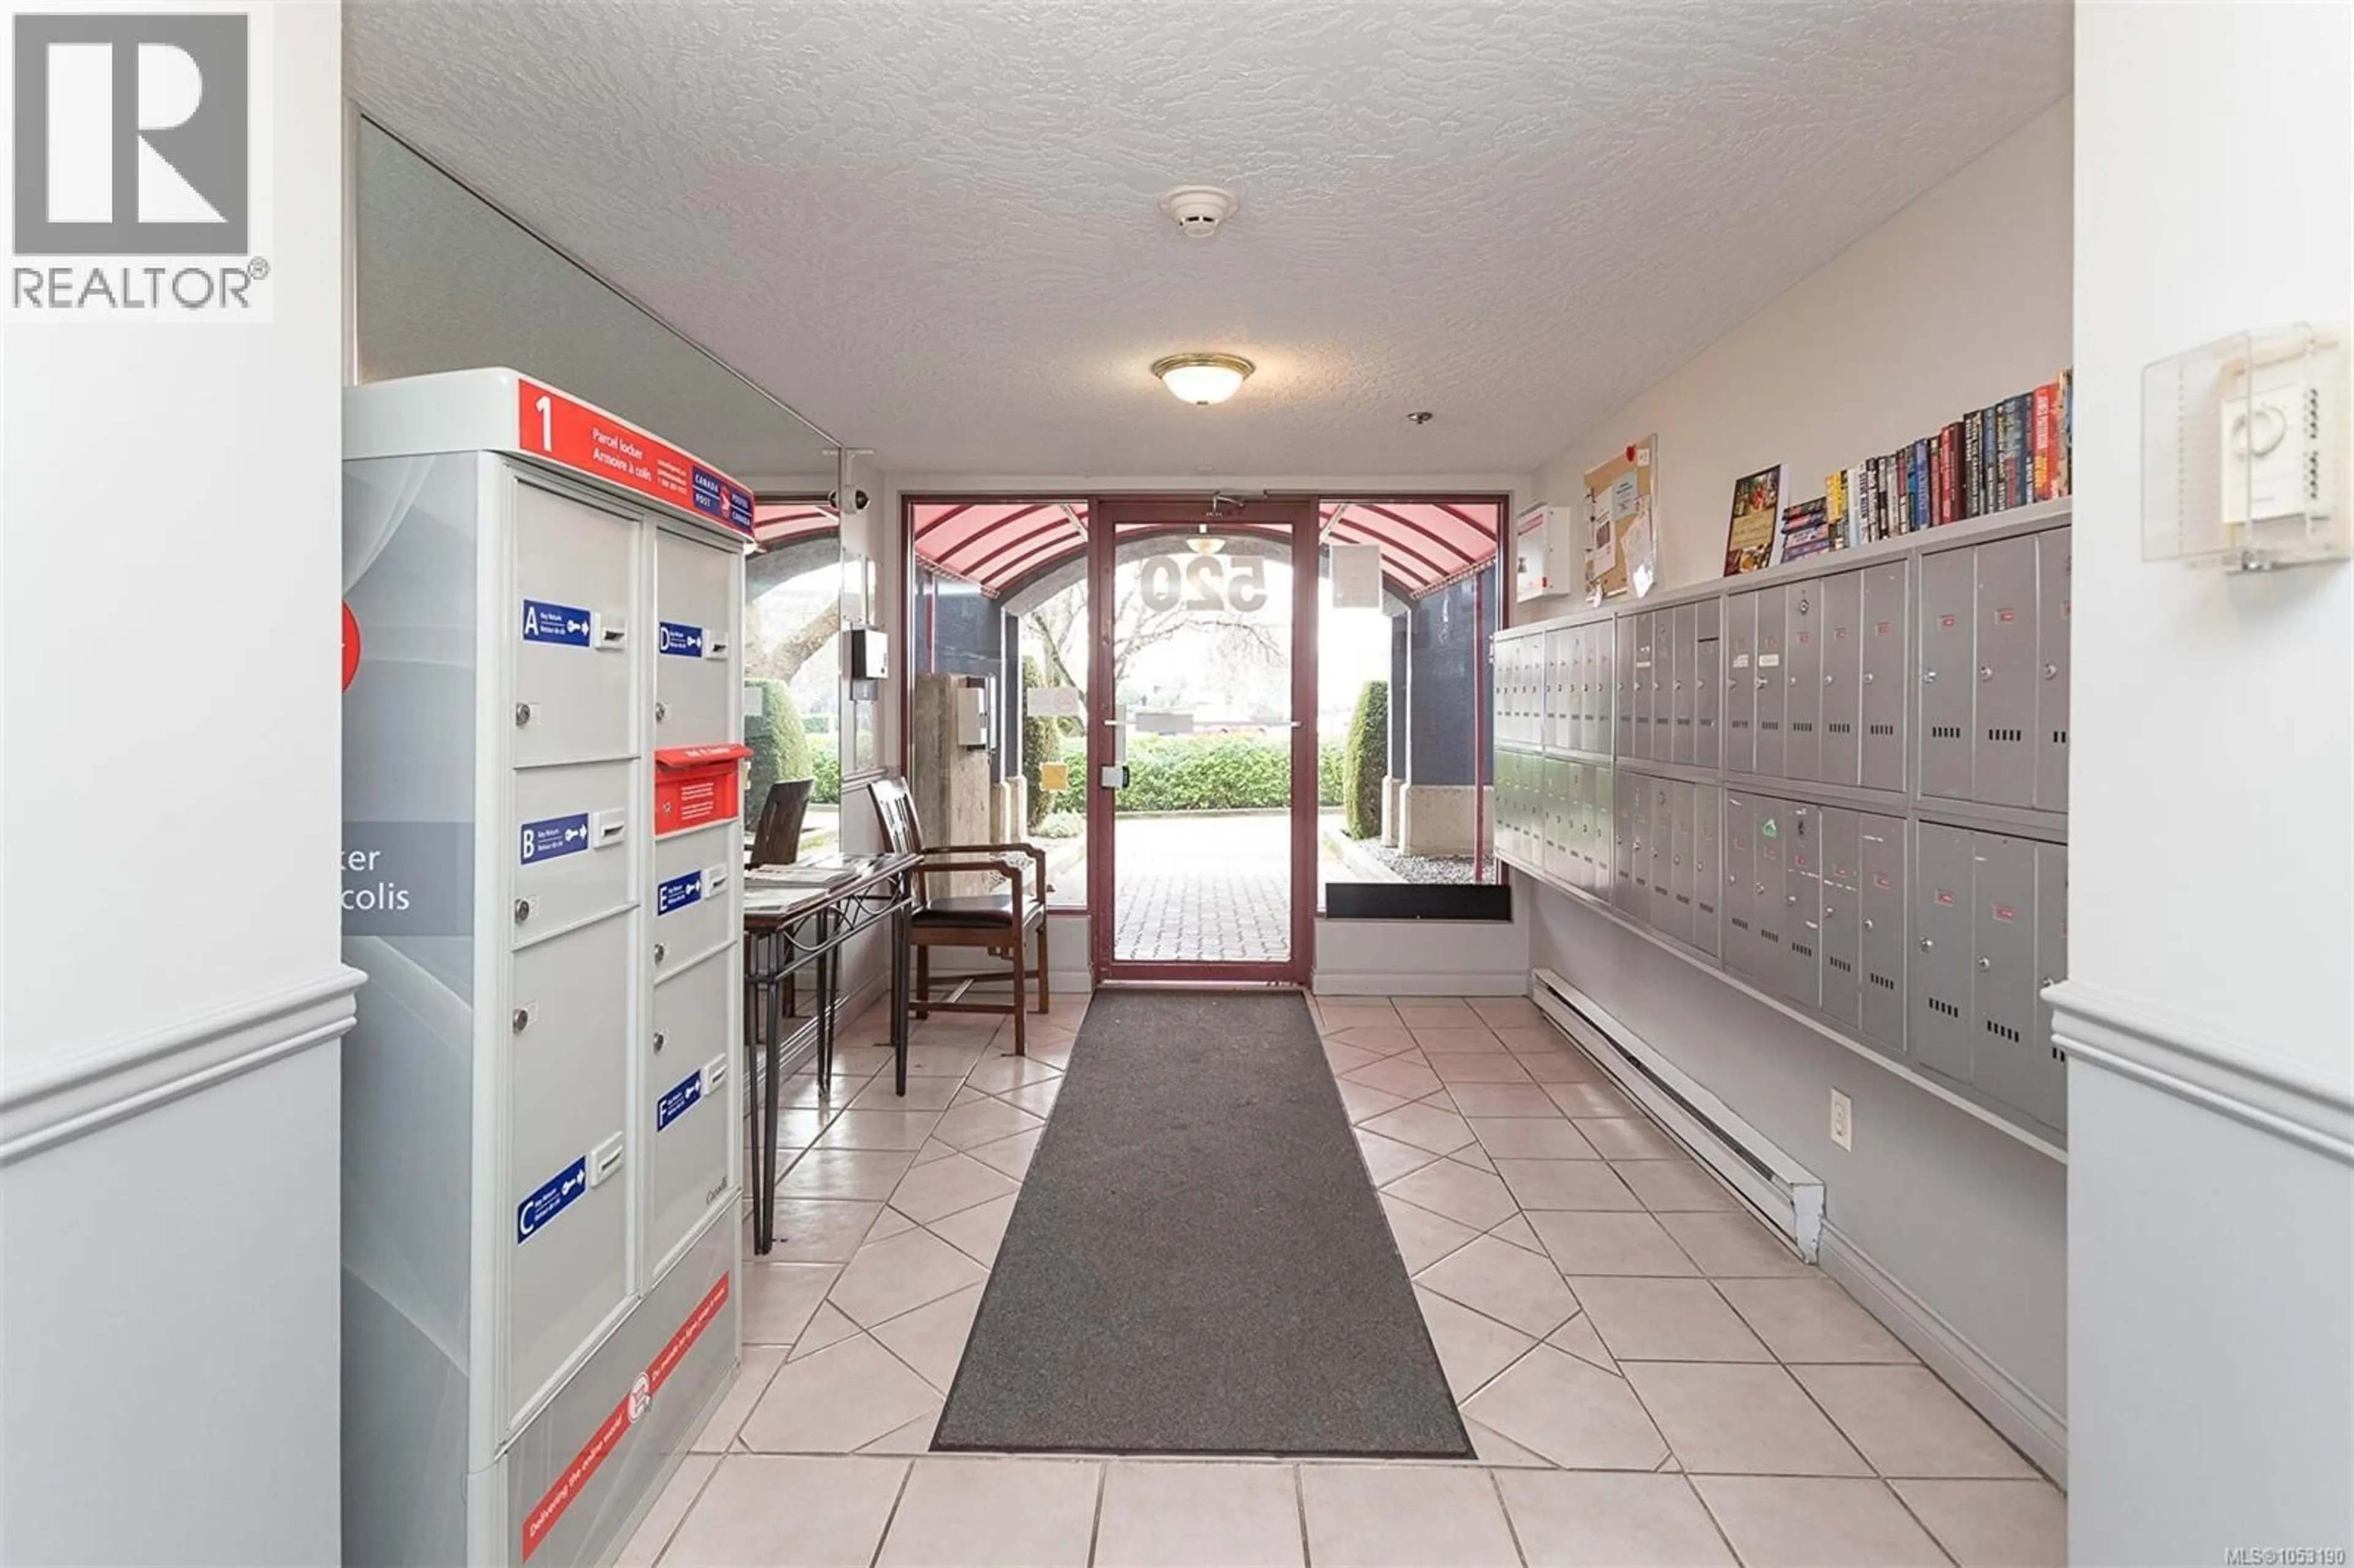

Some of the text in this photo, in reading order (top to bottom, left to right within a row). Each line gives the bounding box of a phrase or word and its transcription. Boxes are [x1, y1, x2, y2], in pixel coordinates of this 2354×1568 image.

[535, 395, 551, 452] 1
[593, 427, 642, 460] Parcel locker
[593, 447, 627, 472] Armoire
[695, 473, 718, 492] CANADA
[695, 493, 710, 508] POST
[525, 606, 539, 636] A
[661, 626, 670, 650] D
[524, 829, 535, 859] B
[341, 850, 381, 870] er
[341, 882, 409, 910] colis
[660, 886, 668, 911] E
[660, 1099, 667, 1127] F
[520, 1200, 534, 1235] C
